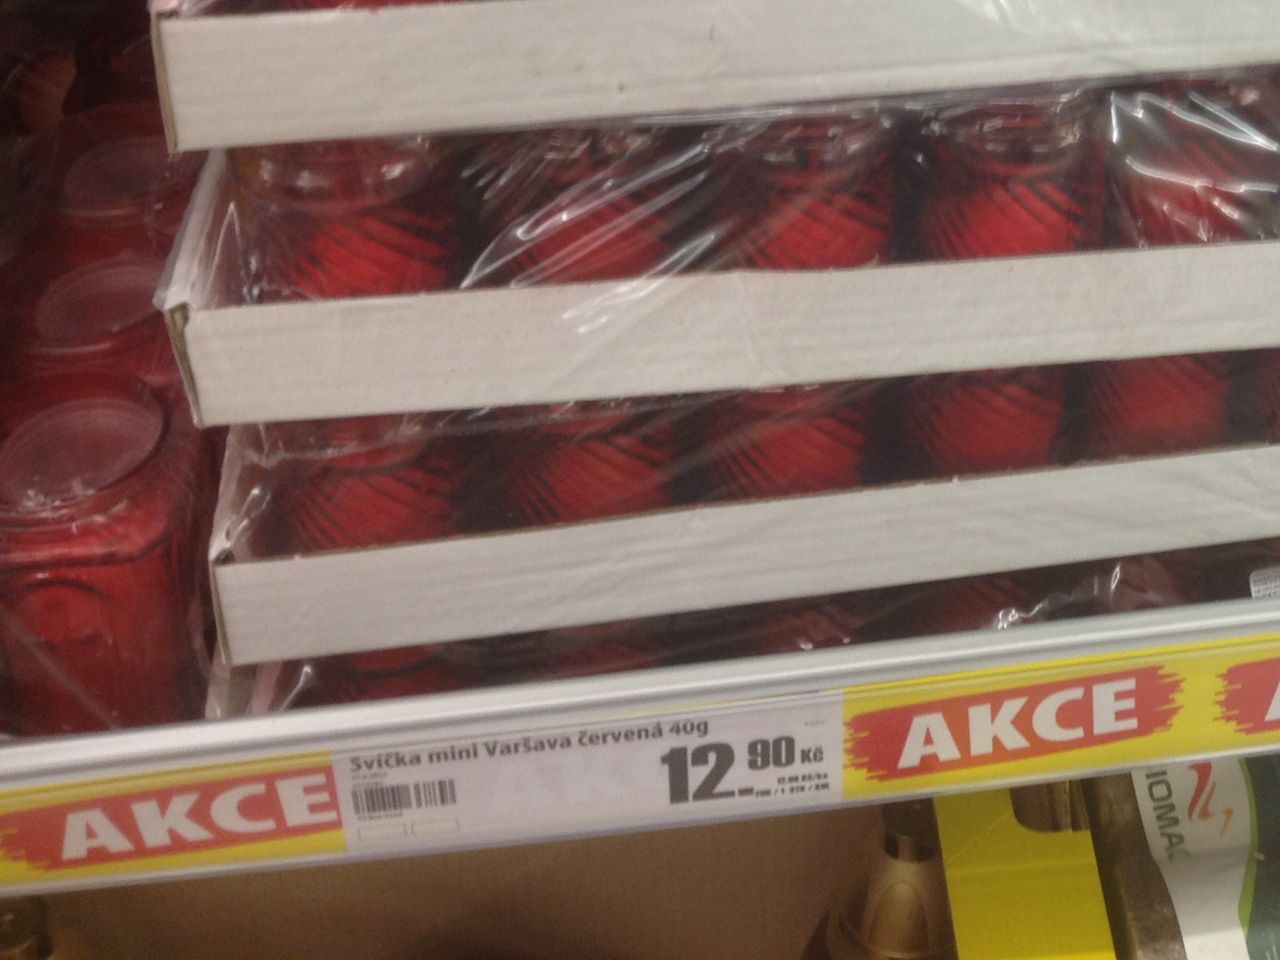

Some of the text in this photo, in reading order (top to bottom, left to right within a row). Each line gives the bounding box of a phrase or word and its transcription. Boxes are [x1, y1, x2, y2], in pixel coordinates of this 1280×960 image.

[350, 720, 709, 773] Svíčka mini Varšava červená 40g
[747, 736, 795, 771] 90
[801, 744, 824, 765] Kč
[896, 678, 1139, 770] AKCE
[61, 773, 338, 861] AKCE
